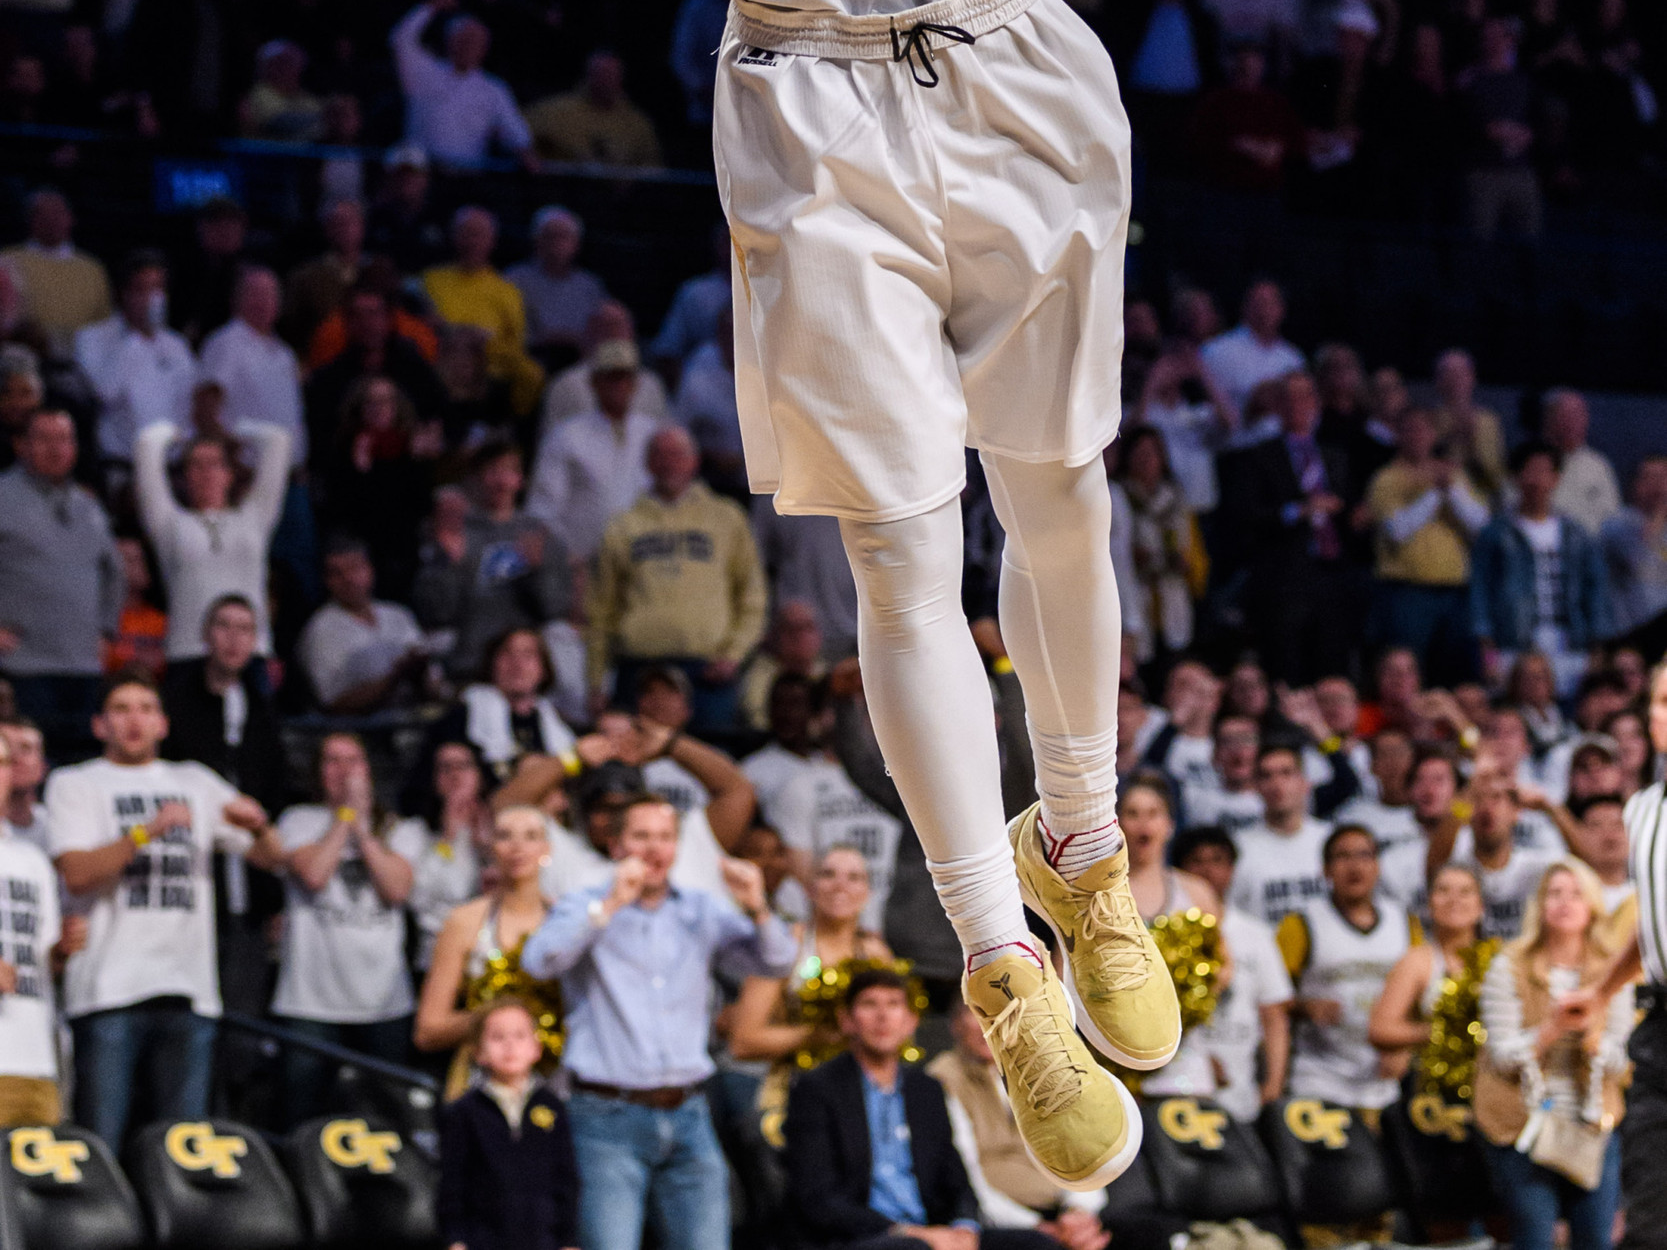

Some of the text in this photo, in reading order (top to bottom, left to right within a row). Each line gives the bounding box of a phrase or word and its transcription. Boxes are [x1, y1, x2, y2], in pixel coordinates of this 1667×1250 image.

[738, 57, 777, 67] RUSSELL
[165, 1121, 248, 1179] GT
[319, 1118, 402, 1174] GT
[1157, 1099, 1228, 1150] GT
[1284, 1099, 1351, 1149] GT
[10, 1126, 90, 1184] GT
